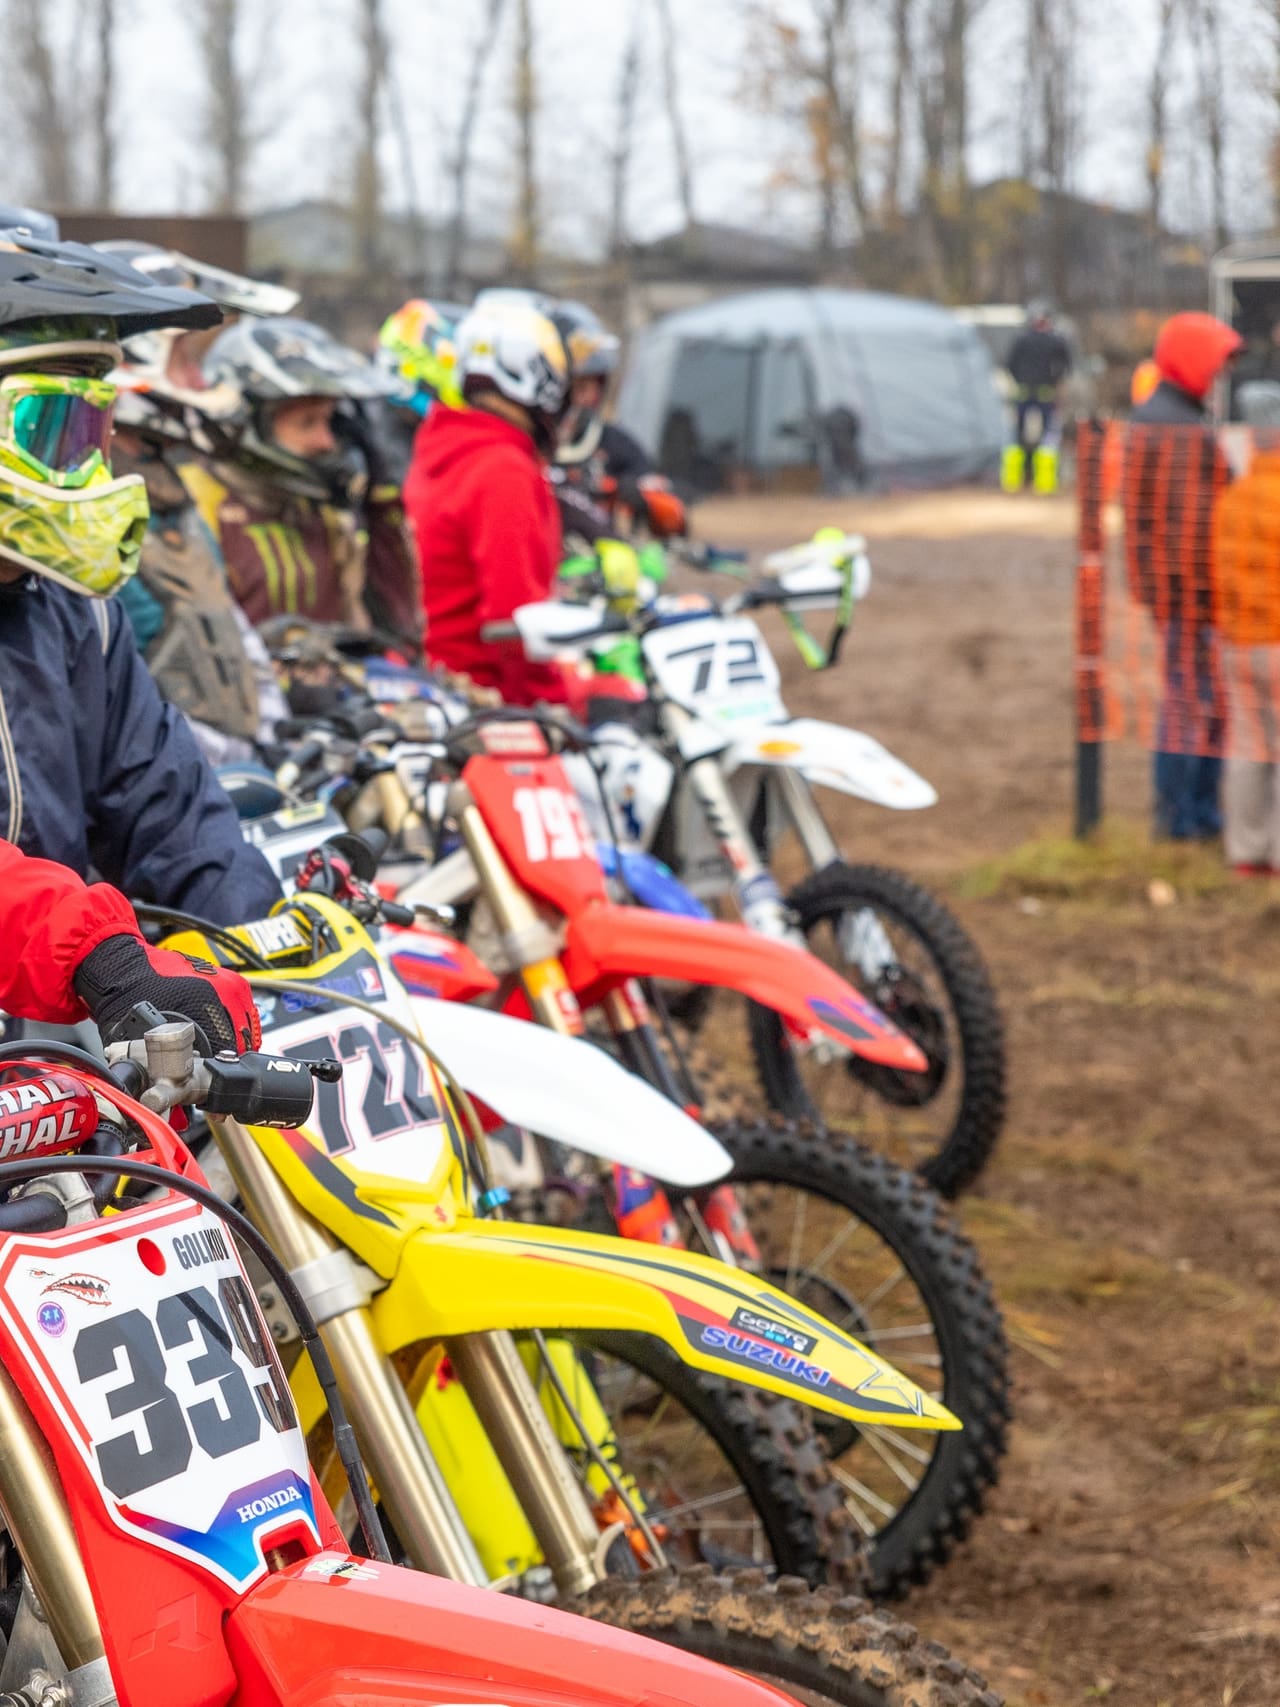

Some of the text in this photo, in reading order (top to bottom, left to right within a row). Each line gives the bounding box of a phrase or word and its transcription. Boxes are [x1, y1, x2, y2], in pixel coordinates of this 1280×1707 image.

[280, 1016, 445, 1159] 722
[172, 1228, 230, 1270] GOLIKOV
[739, 1311, 808, 1346] GoPro
[700, 1325, 831, 1387] SUZUKI
[73, 1275, 298, 1500] 339
[237, 1486, 302, 1523] HONDA
